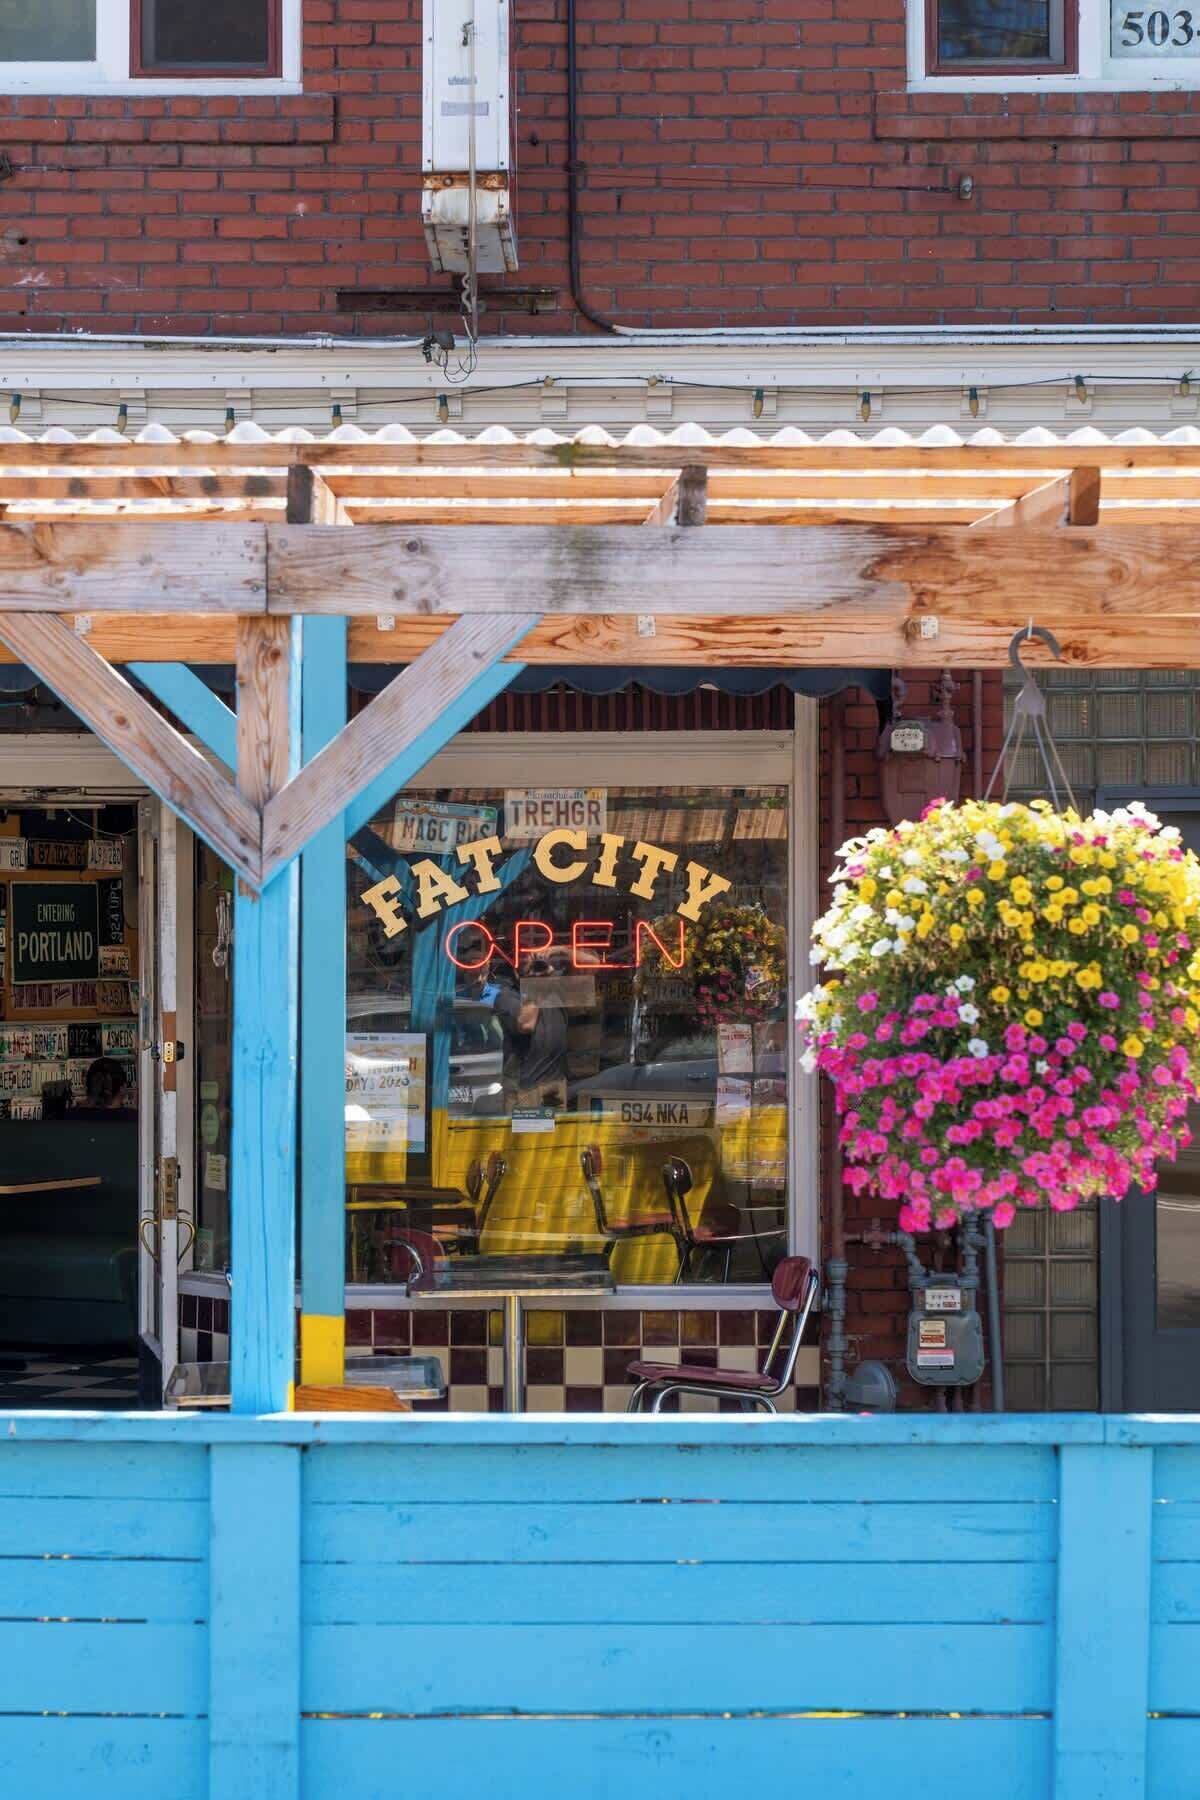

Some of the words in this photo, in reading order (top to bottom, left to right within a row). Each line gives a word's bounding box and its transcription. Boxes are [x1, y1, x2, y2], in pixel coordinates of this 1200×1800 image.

[510, 800, 601, 826] TREHGR
[402, 814, 450, 843] MAGC
[361, 835, 503, 939] FAT
[531, 829, 732, 922] CITY
[38, 903, 75, 922] ENTERING
[18, 931, 94, 963] PORTLAND
[445, 919, 685, 969] OPEN
[620, 1101, 655, 1126] 694
[656, 1101, 689, 1125] NKA
